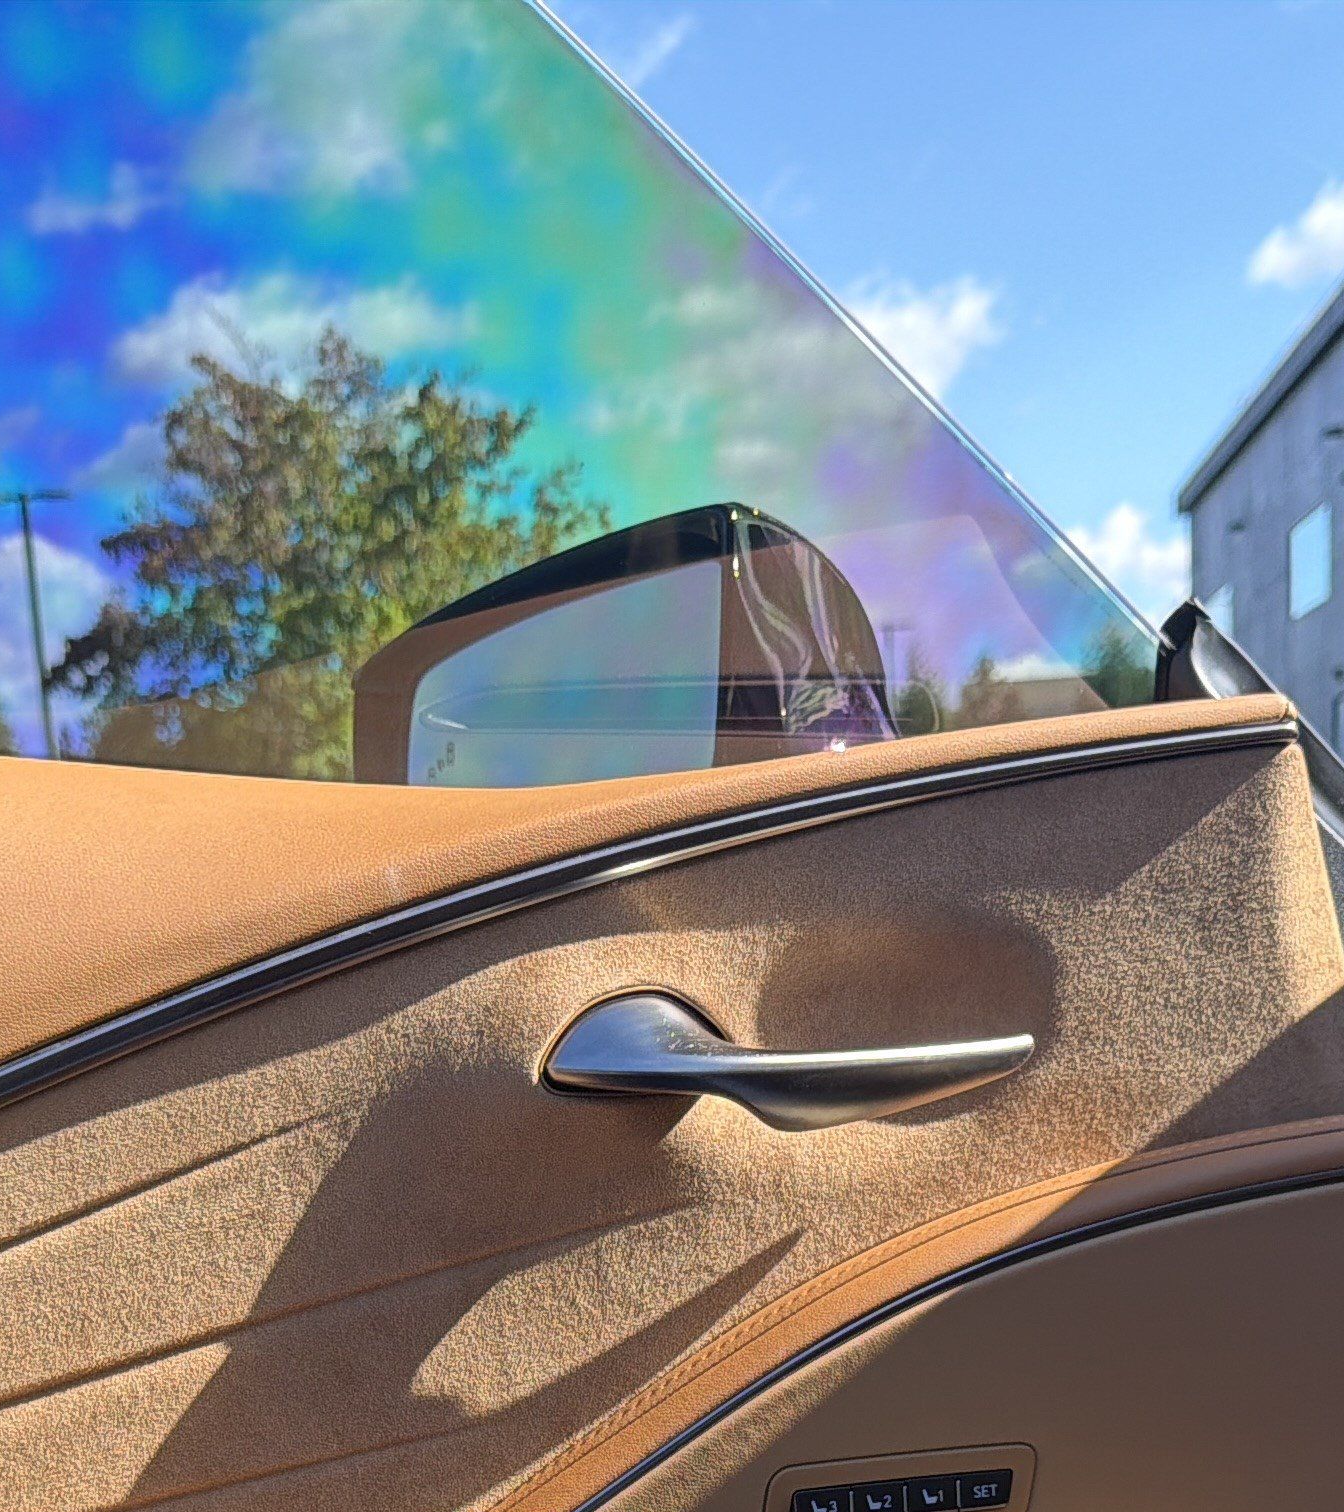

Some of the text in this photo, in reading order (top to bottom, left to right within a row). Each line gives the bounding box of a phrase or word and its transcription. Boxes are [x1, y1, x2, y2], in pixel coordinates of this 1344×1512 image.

[883, 1495, 892, 1508] 2
[938, 1490, 944, 1502] 1
[972, 1484, 998, 1499] SET
